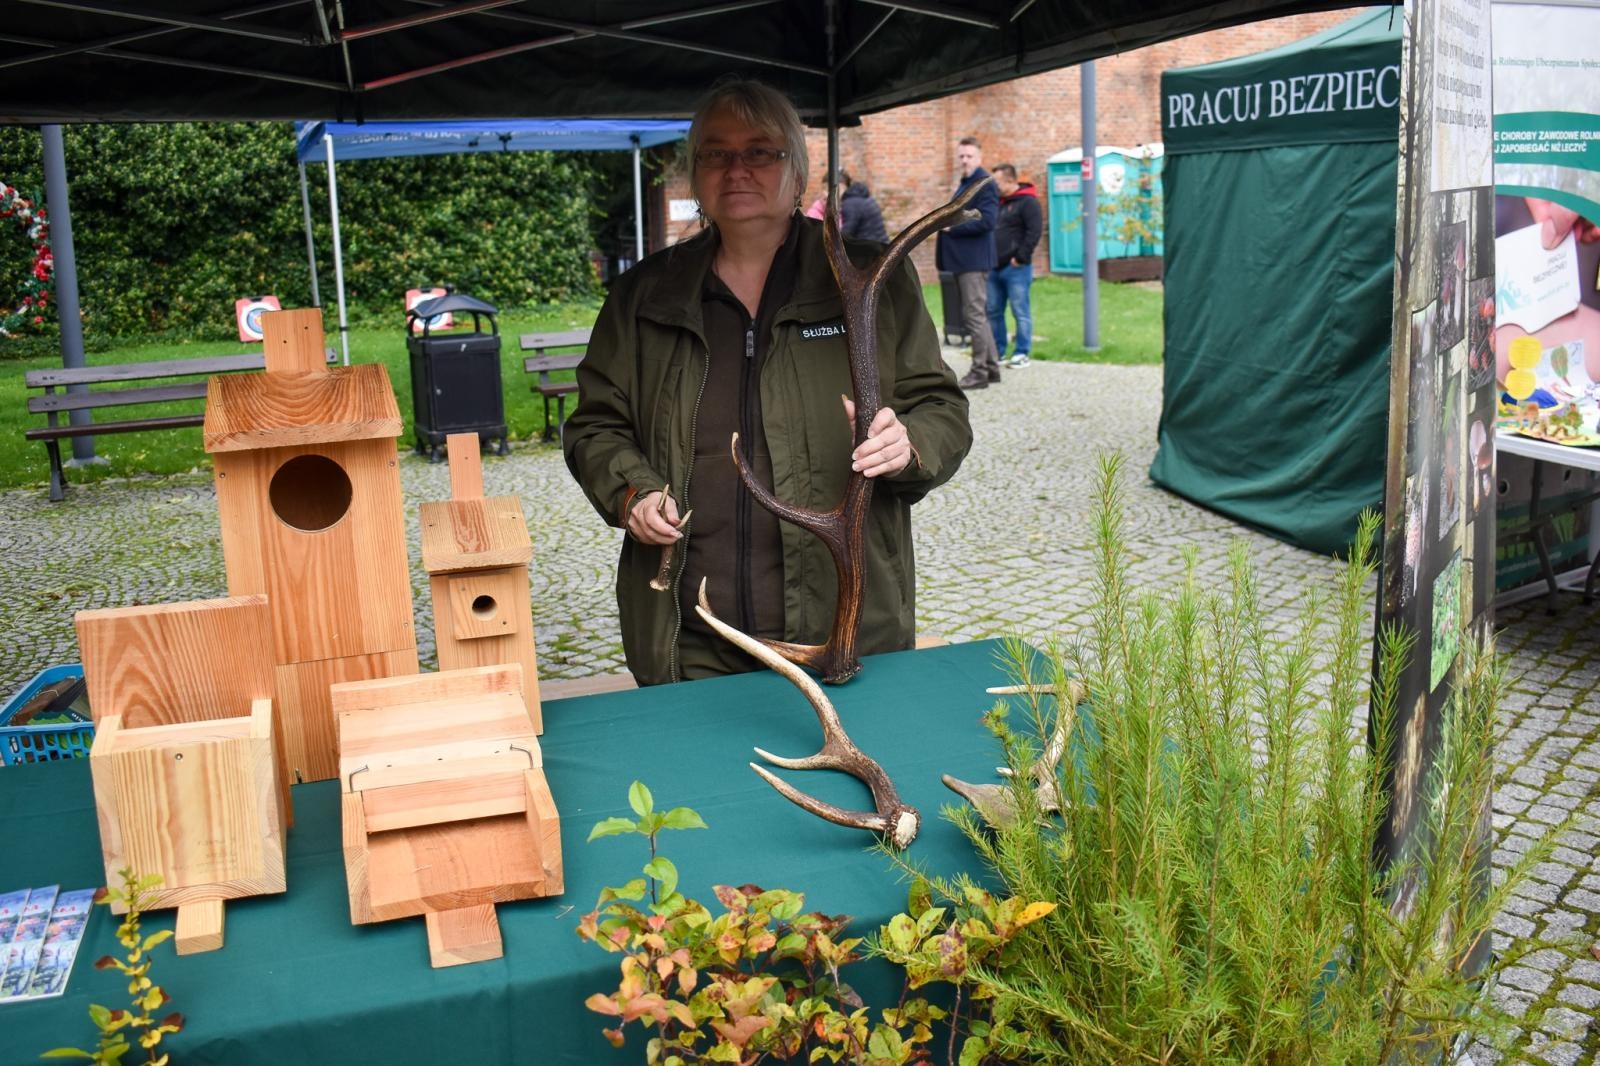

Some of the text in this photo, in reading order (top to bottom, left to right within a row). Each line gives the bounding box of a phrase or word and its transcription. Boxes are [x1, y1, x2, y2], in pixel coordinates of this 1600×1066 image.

[1168, 83, 1263, 128] PRACUJ
[1268, 65, 1400, 118] BEZPIEC
[1501, 131, 1537, 140] CHOROBY
[1538, 131, 1579, 140] ZAWODOWE
[1501, 141, 1549, 153] ZAPOBIEGAĆ
[1562, 141, 1587, 152] LECZYĆ
[803, 326, 839, 338] SŁUŻBA
